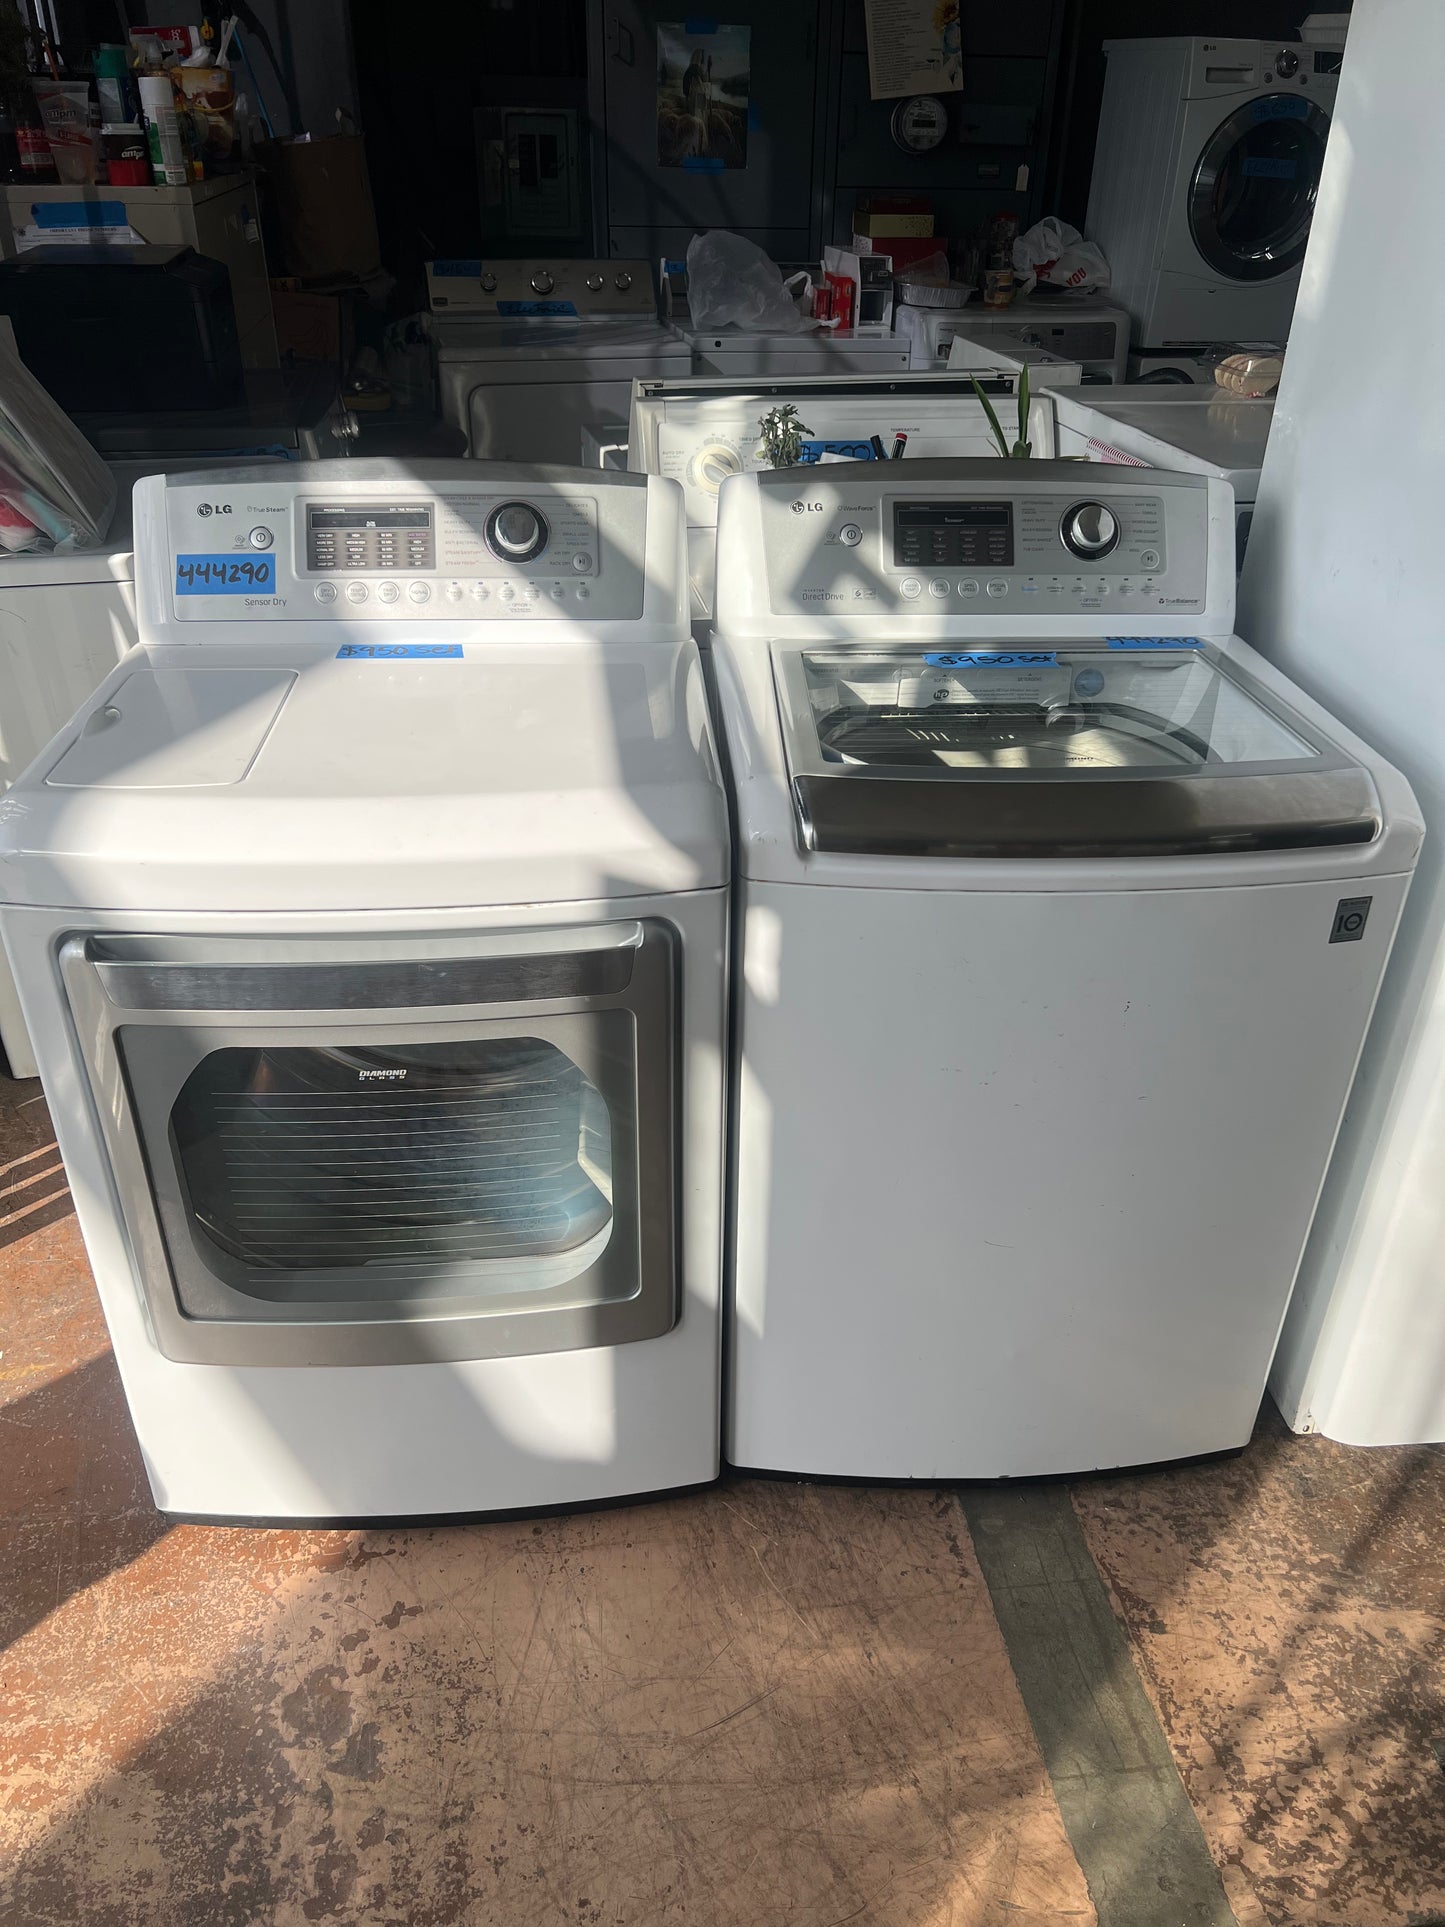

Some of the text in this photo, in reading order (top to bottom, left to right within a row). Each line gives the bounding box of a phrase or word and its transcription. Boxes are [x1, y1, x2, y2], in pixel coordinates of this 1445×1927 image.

[215, 504, 233, 515] LG
[807, 503, 823, 512] LG
[178, 562, 269, 586] 444290
[244, 598, 287, 607] Sensor Dry
[342, 644, 408, 656] $950
[938, 655, 1014, 665] $950
[359, 1069, 407, 1077] DIAMOND
